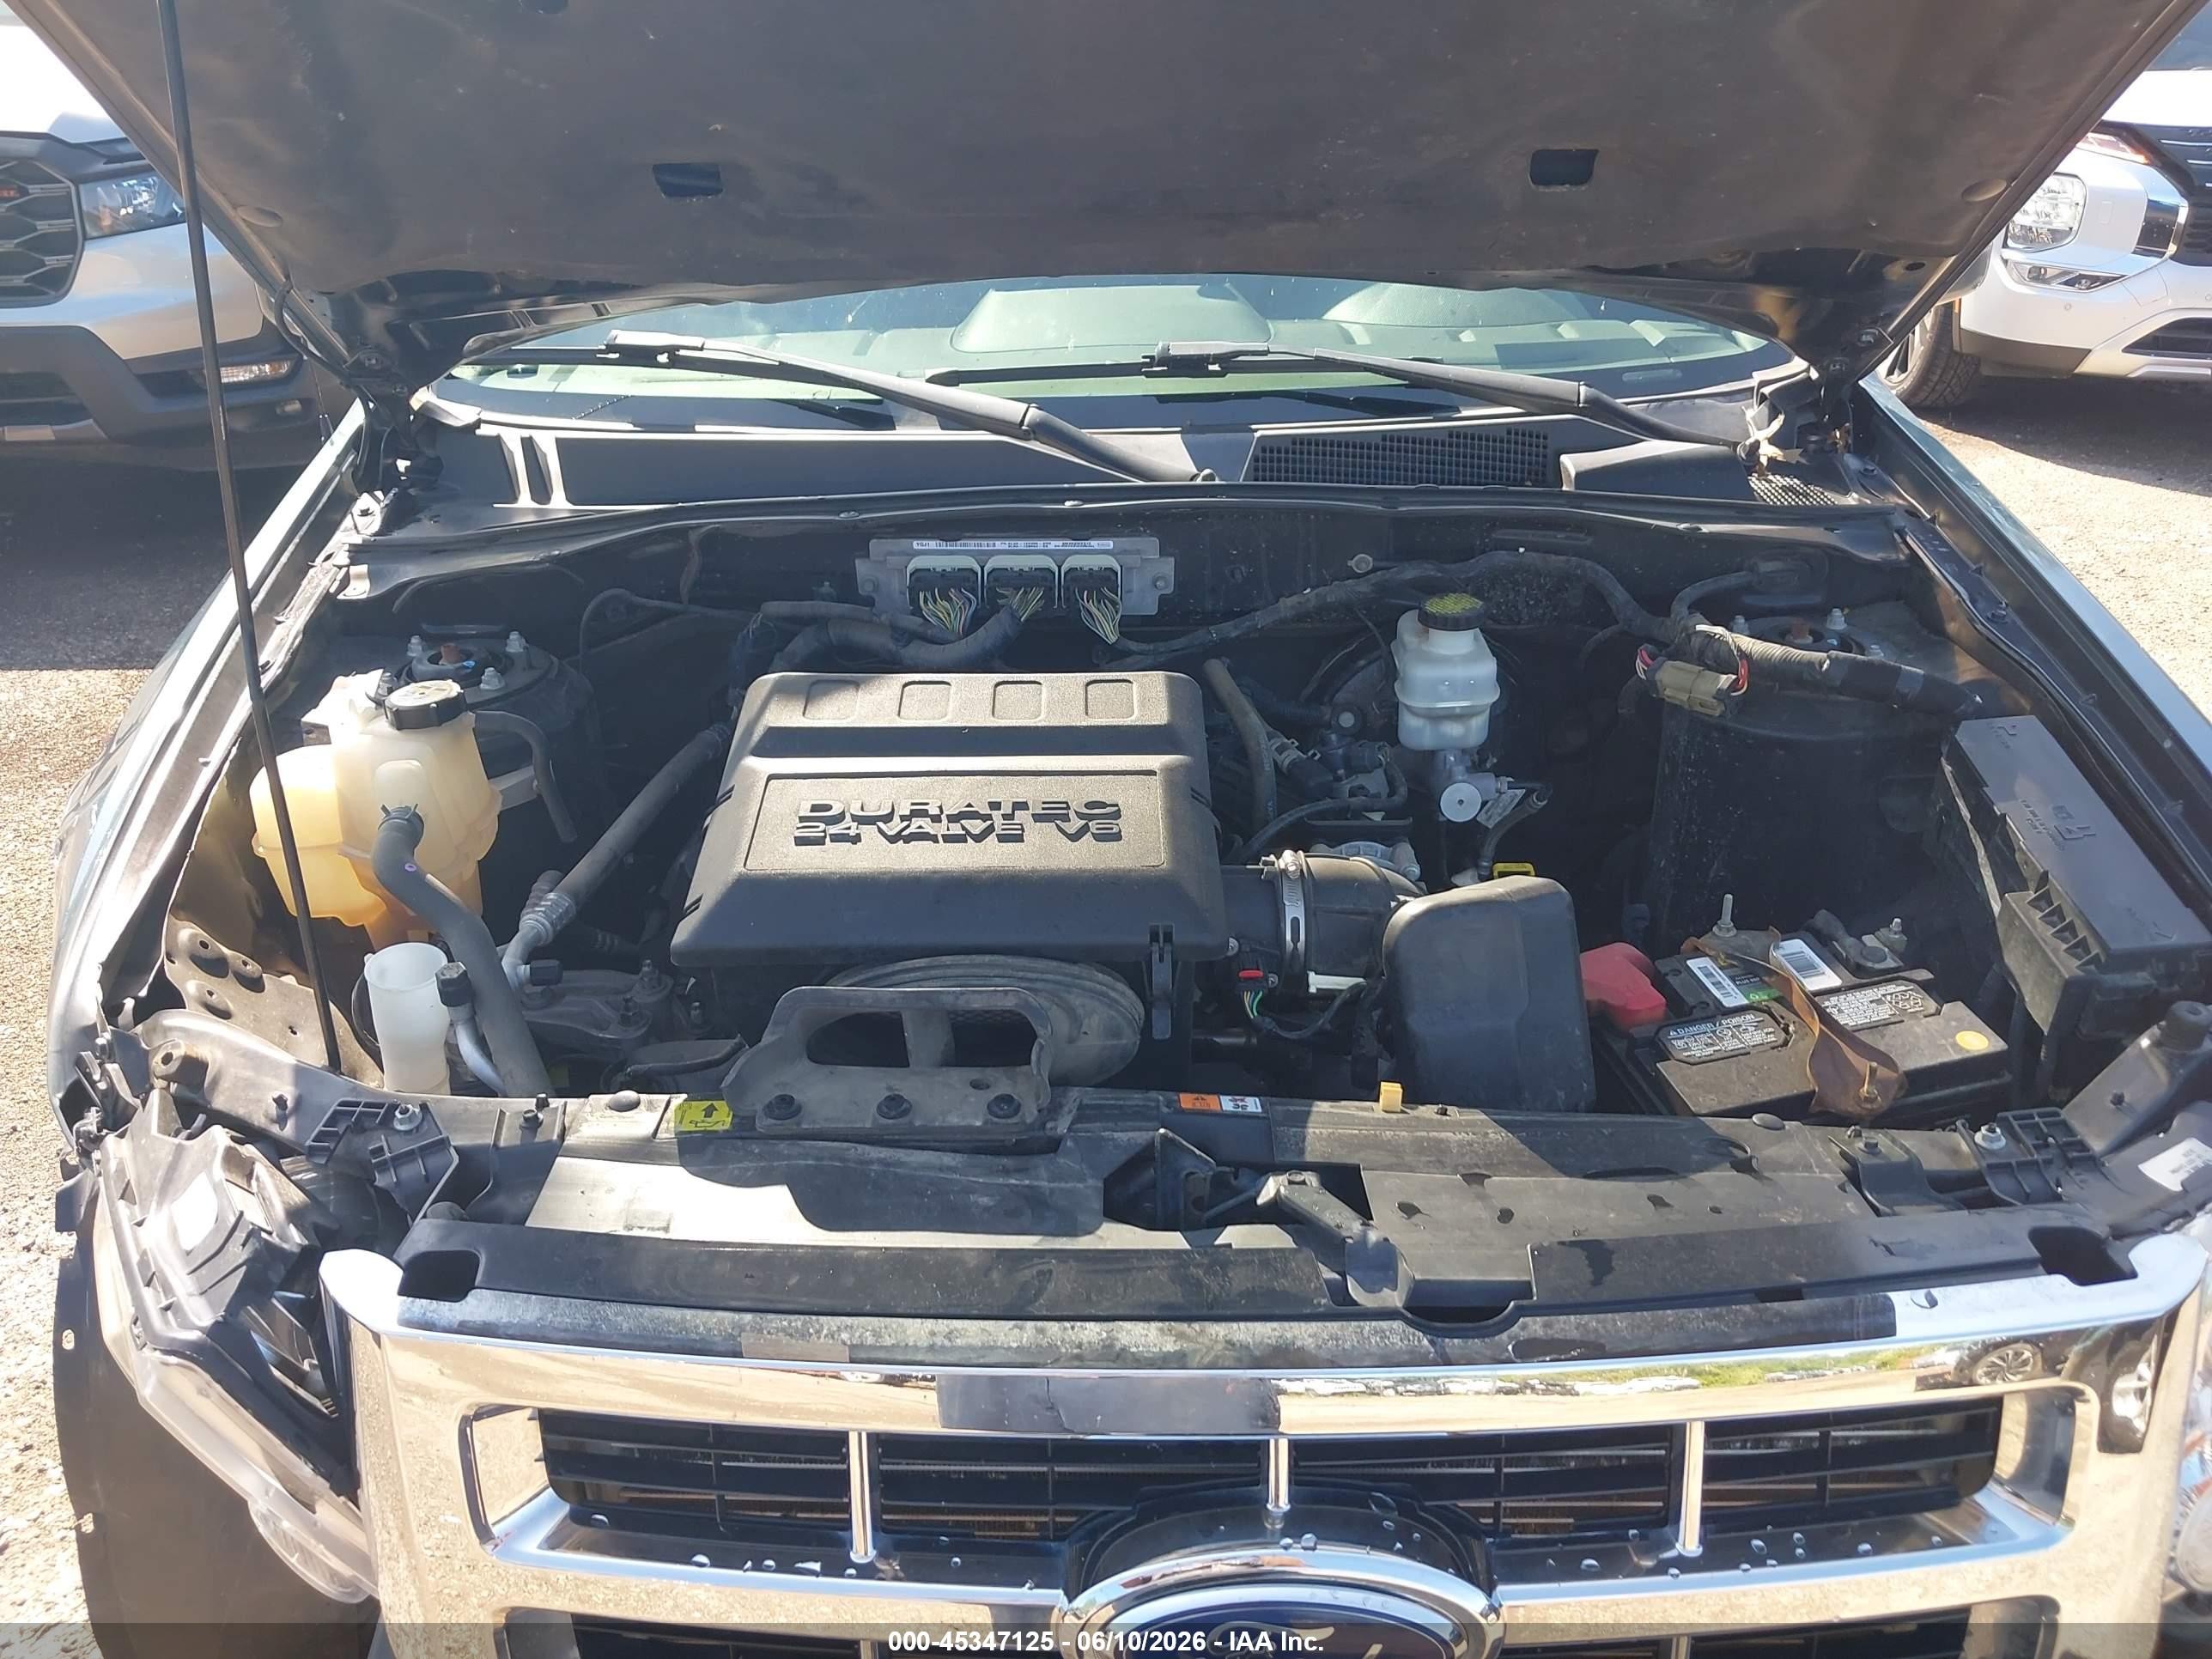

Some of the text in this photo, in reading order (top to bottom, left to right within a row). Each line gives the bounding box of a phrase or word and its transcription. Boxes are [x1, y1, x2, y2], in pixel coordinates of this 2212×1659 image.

[797, 799, 1121, 823] DURATEC
[794, 819, 1123, 846] 24 VALVE V6
[1677, 1022, 1714, 1034] DANGER
[1722, 1014, 1755, 1025] POISON
